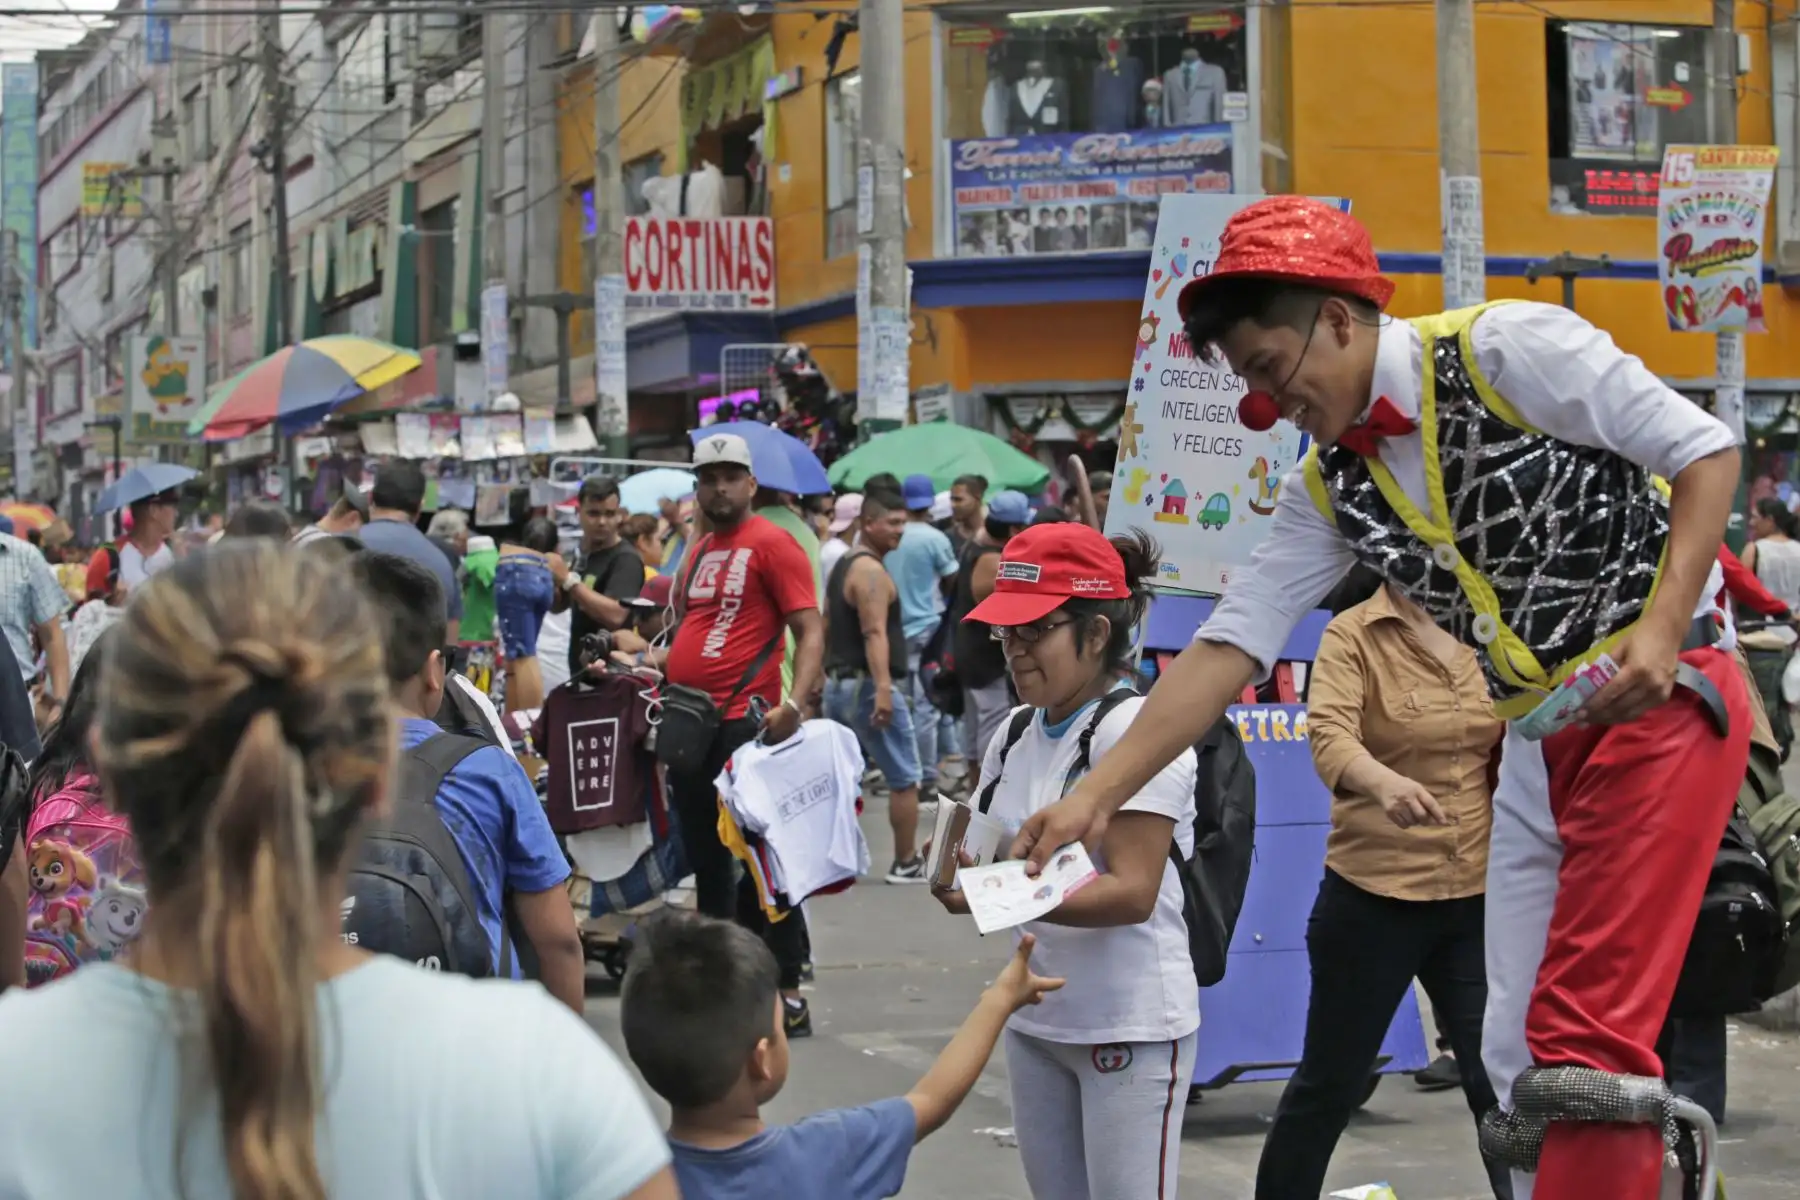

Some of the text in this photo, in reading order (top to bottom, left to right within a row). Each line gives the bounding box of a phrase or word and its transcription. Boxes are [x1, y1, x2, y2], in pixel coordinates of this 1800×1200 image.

[625, 219, 771, 292] CORTINAS
[1160, 369, 1218, 390] CRECEN
[1162, 401, 1241, 424] INTELIGEN
[1173, 433, 1243, 457] Y FELICES
[701, 597, 742, 657] DENIM
